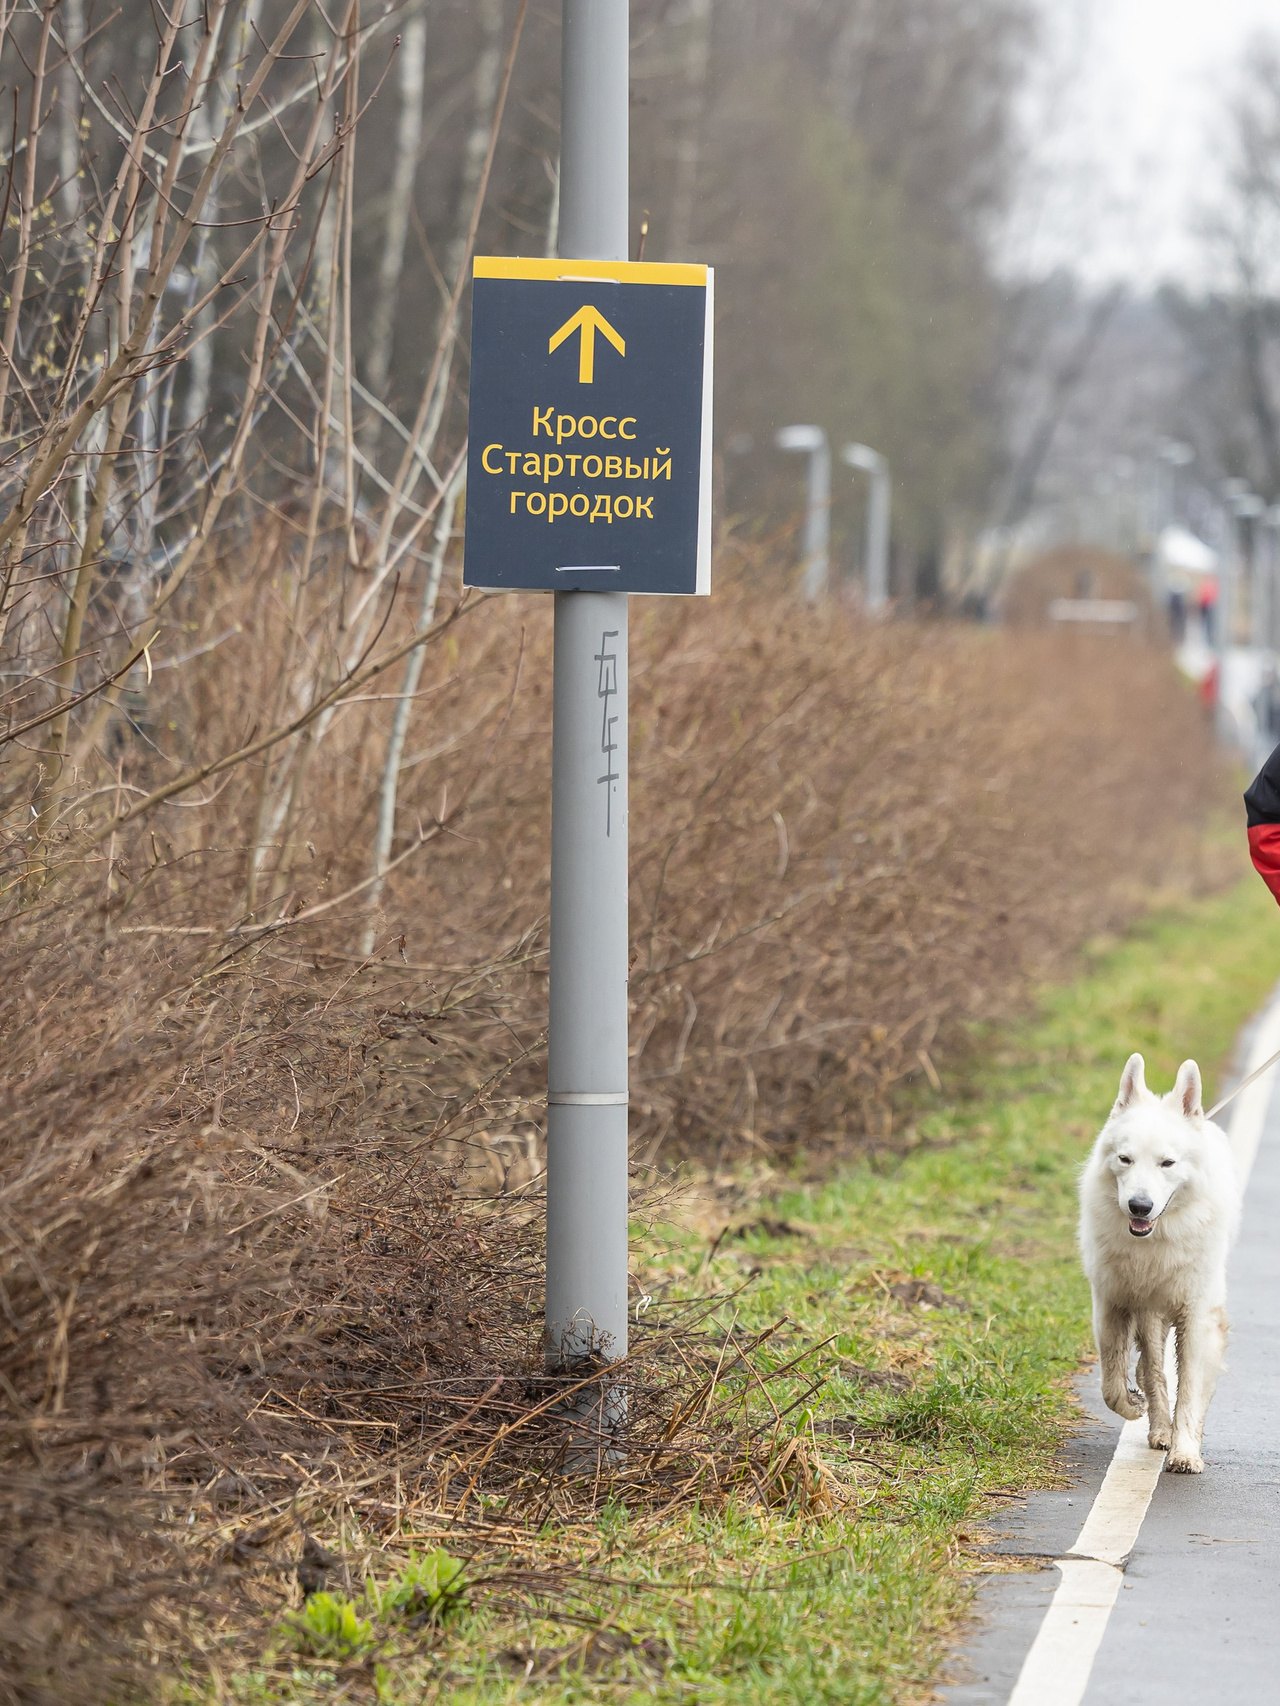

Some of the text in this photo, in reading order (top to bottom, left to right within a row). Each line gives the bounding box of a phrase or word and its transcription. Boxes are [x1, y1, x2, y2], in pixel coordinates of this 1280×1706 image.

[532, 406, 637, 445] Кросс
[481, 443, 672, 483] Стартовый
[510, 491, 654, 523] городок
